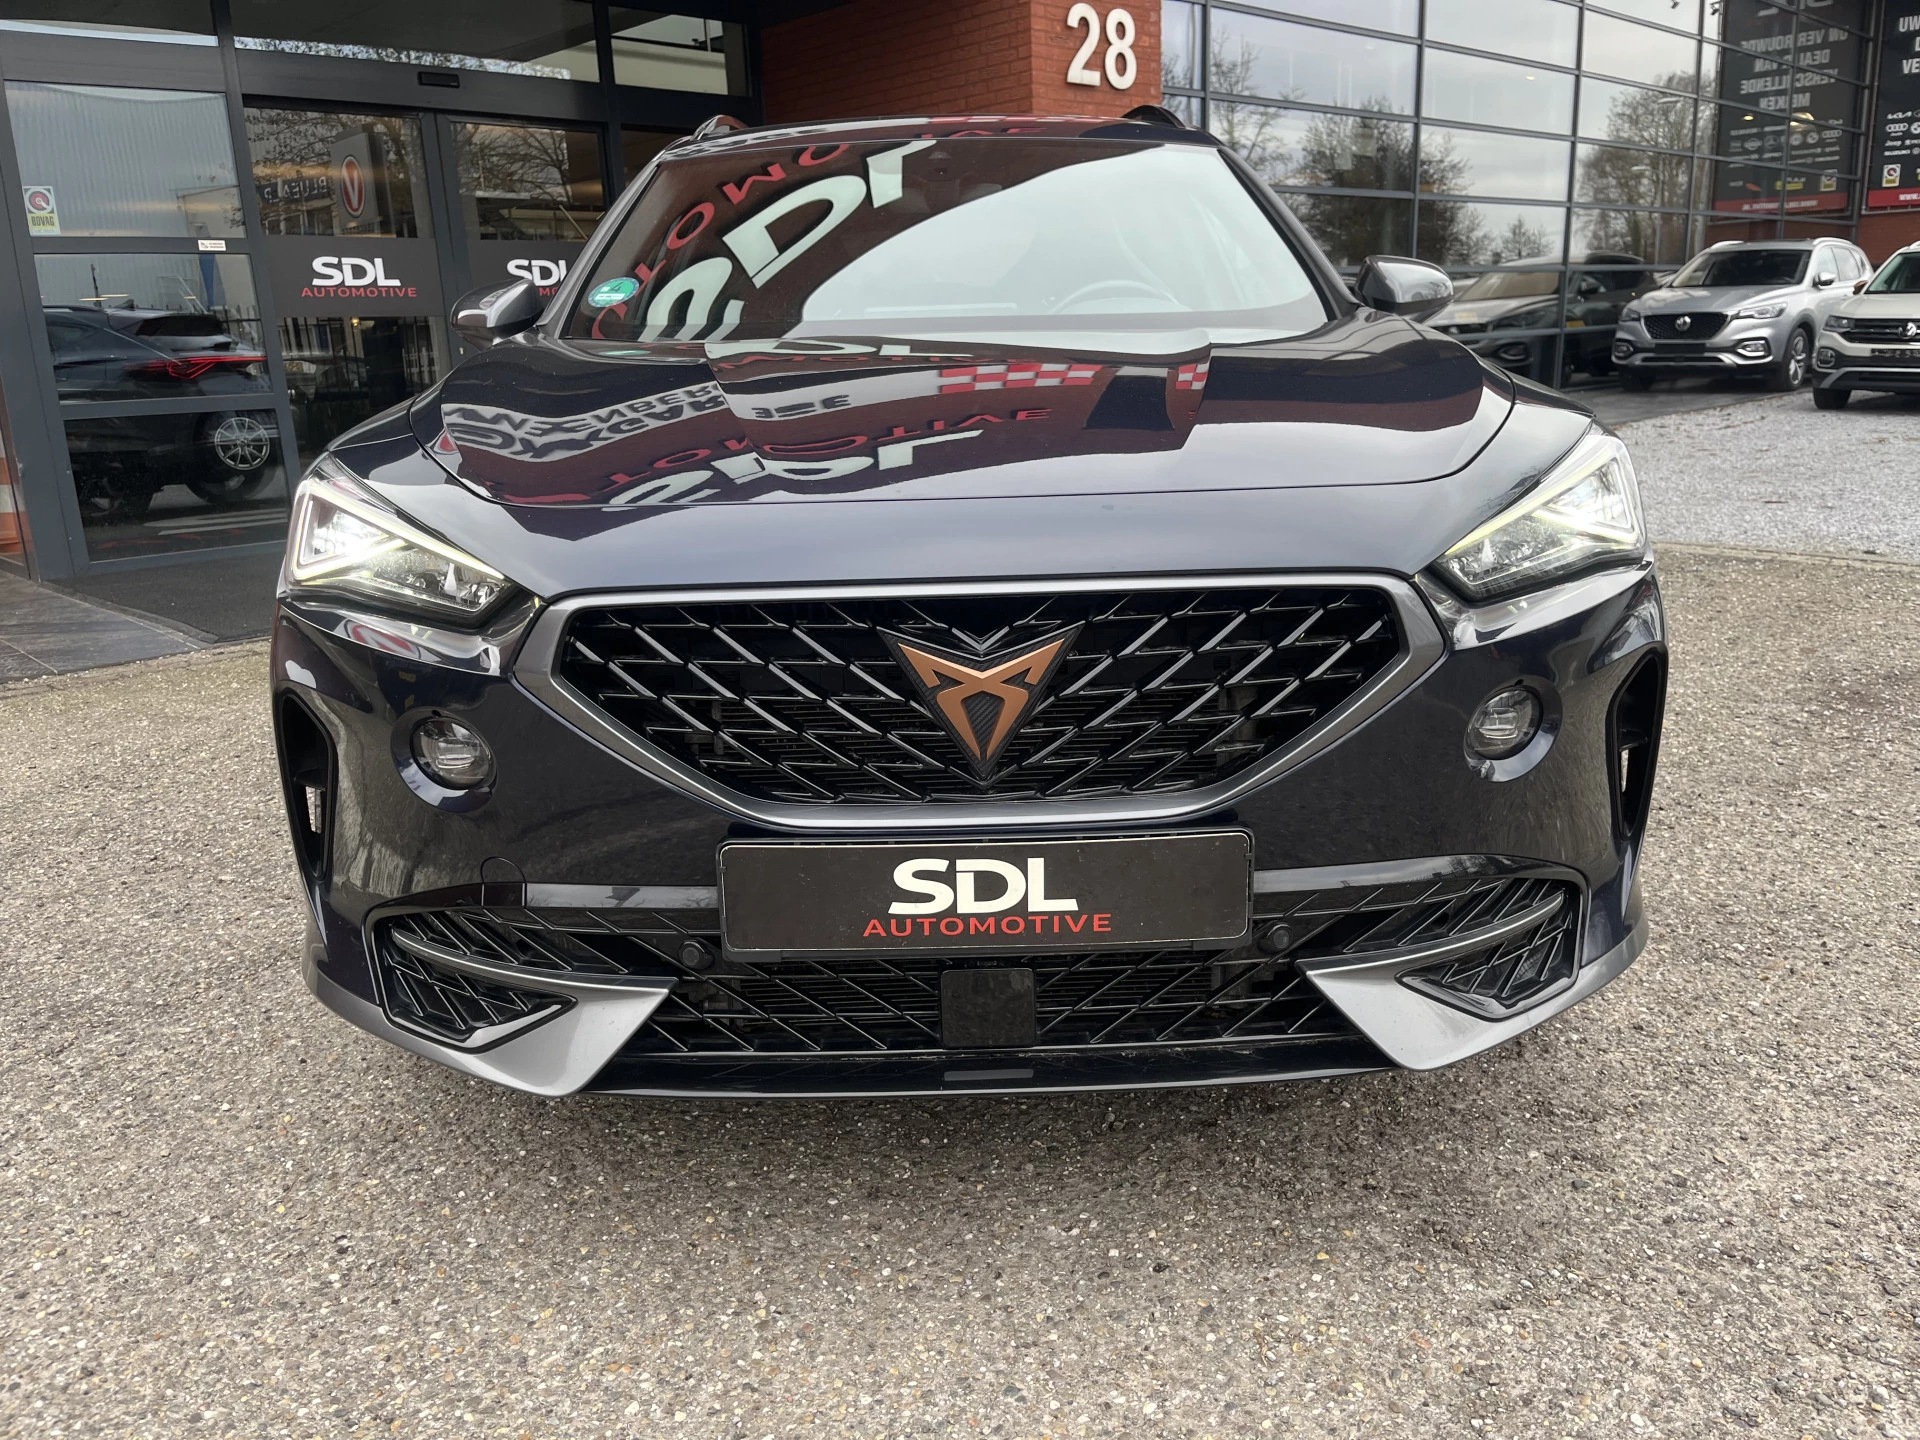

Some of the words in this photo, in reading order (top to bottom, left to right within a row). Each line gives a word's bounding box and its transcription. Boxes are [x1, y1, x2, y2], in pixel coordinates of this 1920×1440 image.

[1066, 3, 1138, 90] 28
[31, 216, 55, 226] BOVAG
[312, 256, 401, 286] SDL
[301, 287, 417, 297] AUTOMOTIVE
[888, 857, 1079, 914] SDL
[863, 913, 1112, 938] AUTOMOTIVE
